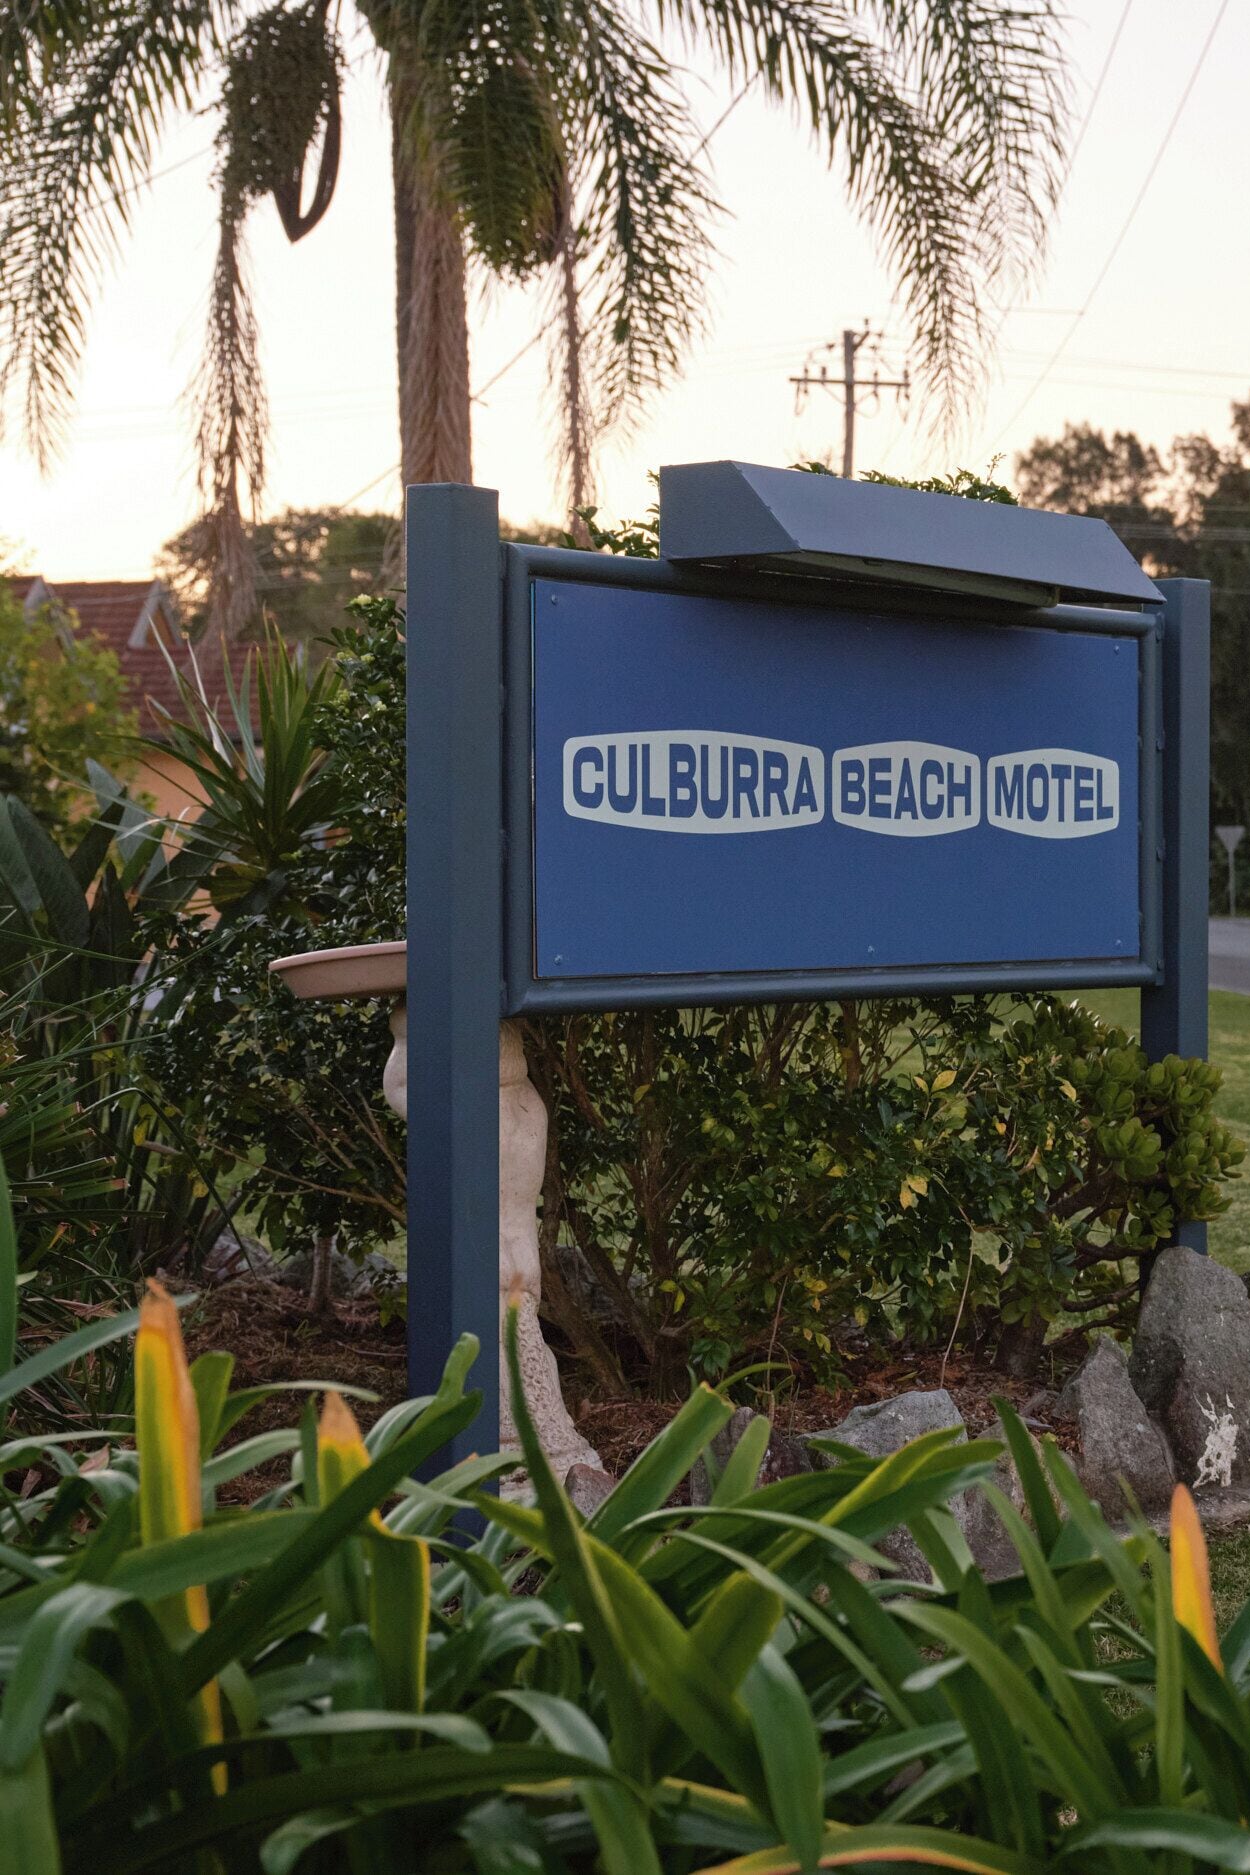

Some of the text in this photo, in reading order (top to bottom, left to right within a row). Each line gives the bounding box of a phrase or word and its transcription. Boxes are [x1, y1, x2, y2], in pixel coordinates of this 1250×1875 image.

[572, 743, 1114, 822] CULBURRA BEACH MOTEL
